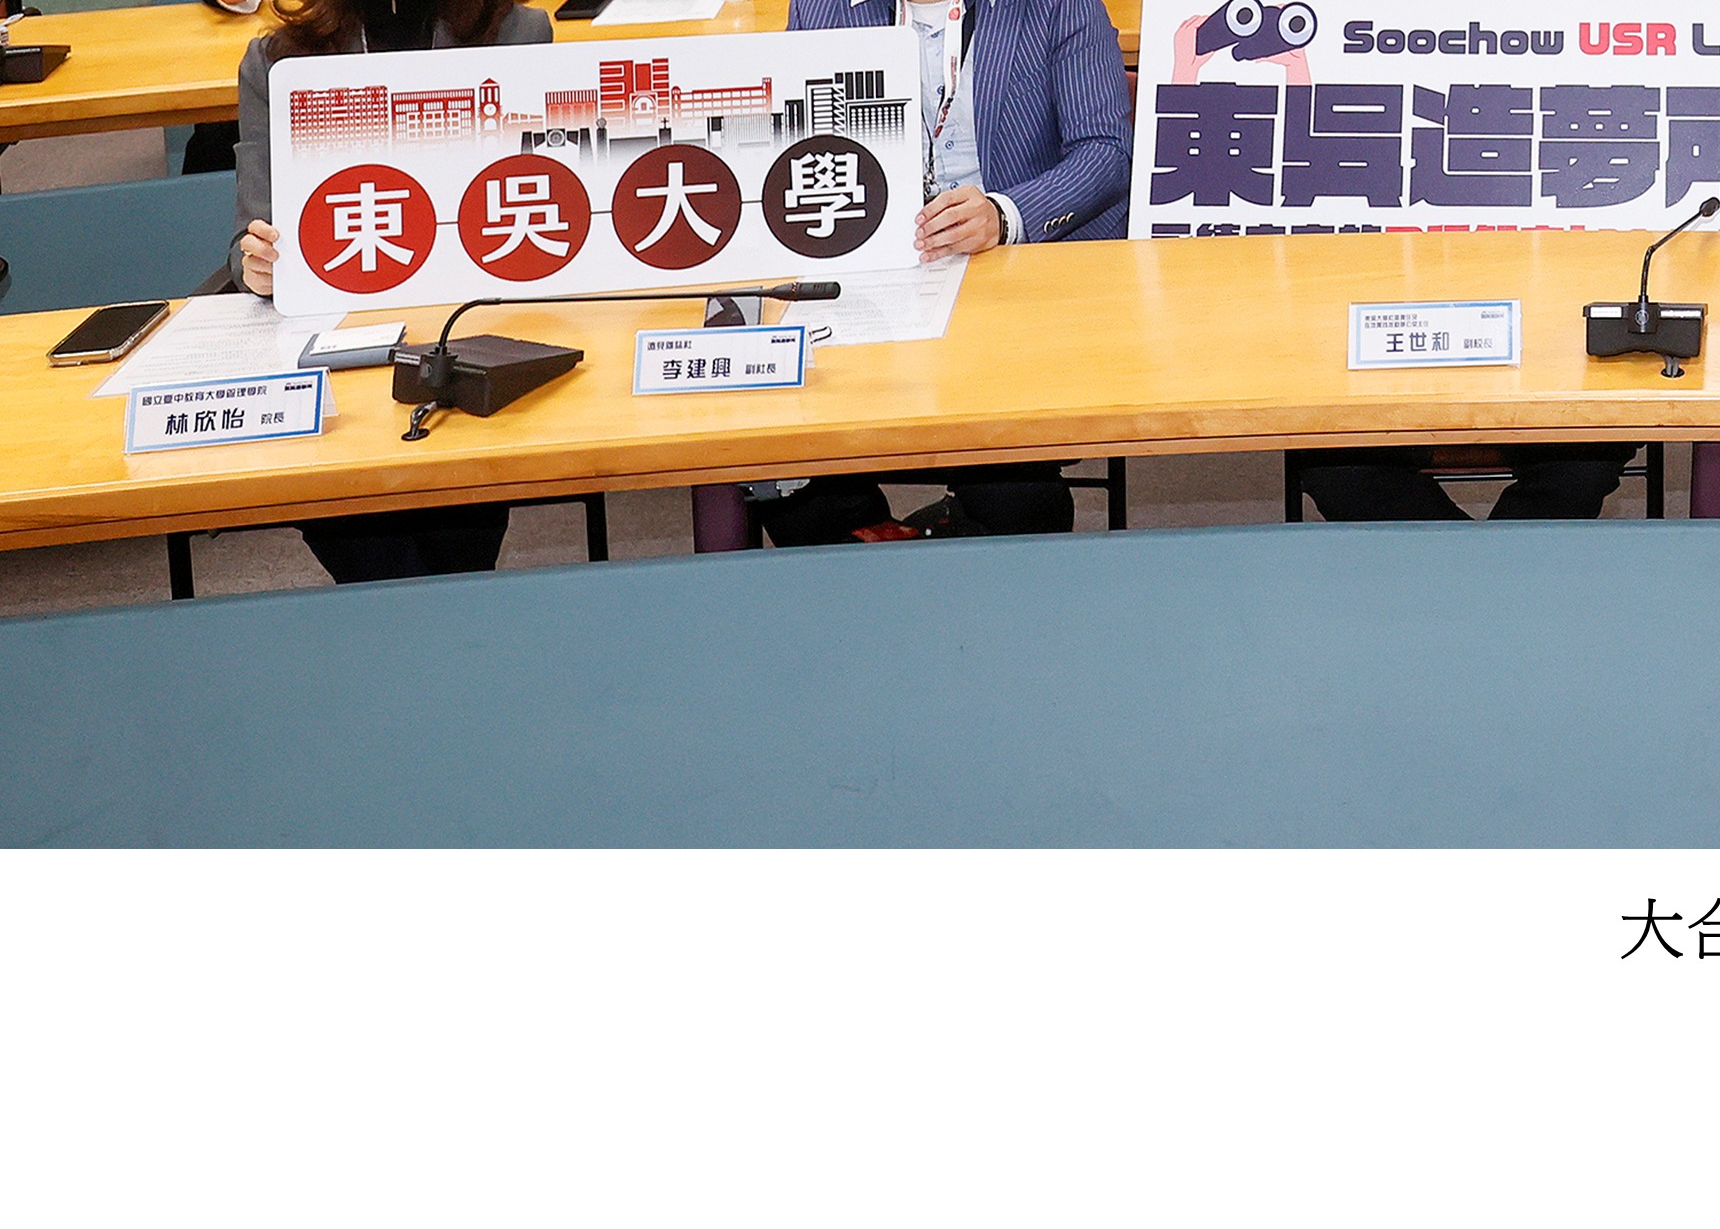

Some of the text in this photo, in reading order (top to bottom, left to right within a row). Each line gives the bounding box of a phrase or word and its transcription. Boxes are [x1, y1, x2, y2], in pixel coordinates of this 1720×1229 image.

[1342, 20, 1564, 56] Soochow
[1578, 22, 1677, 56] USR
[323, 152, 866, 274] 東吳大學
[1386, 332, 1449, 353] 王世和
[662, 357, 731, 380] 李建興
[164, 407, 285, 435] 林欣怡 院長
